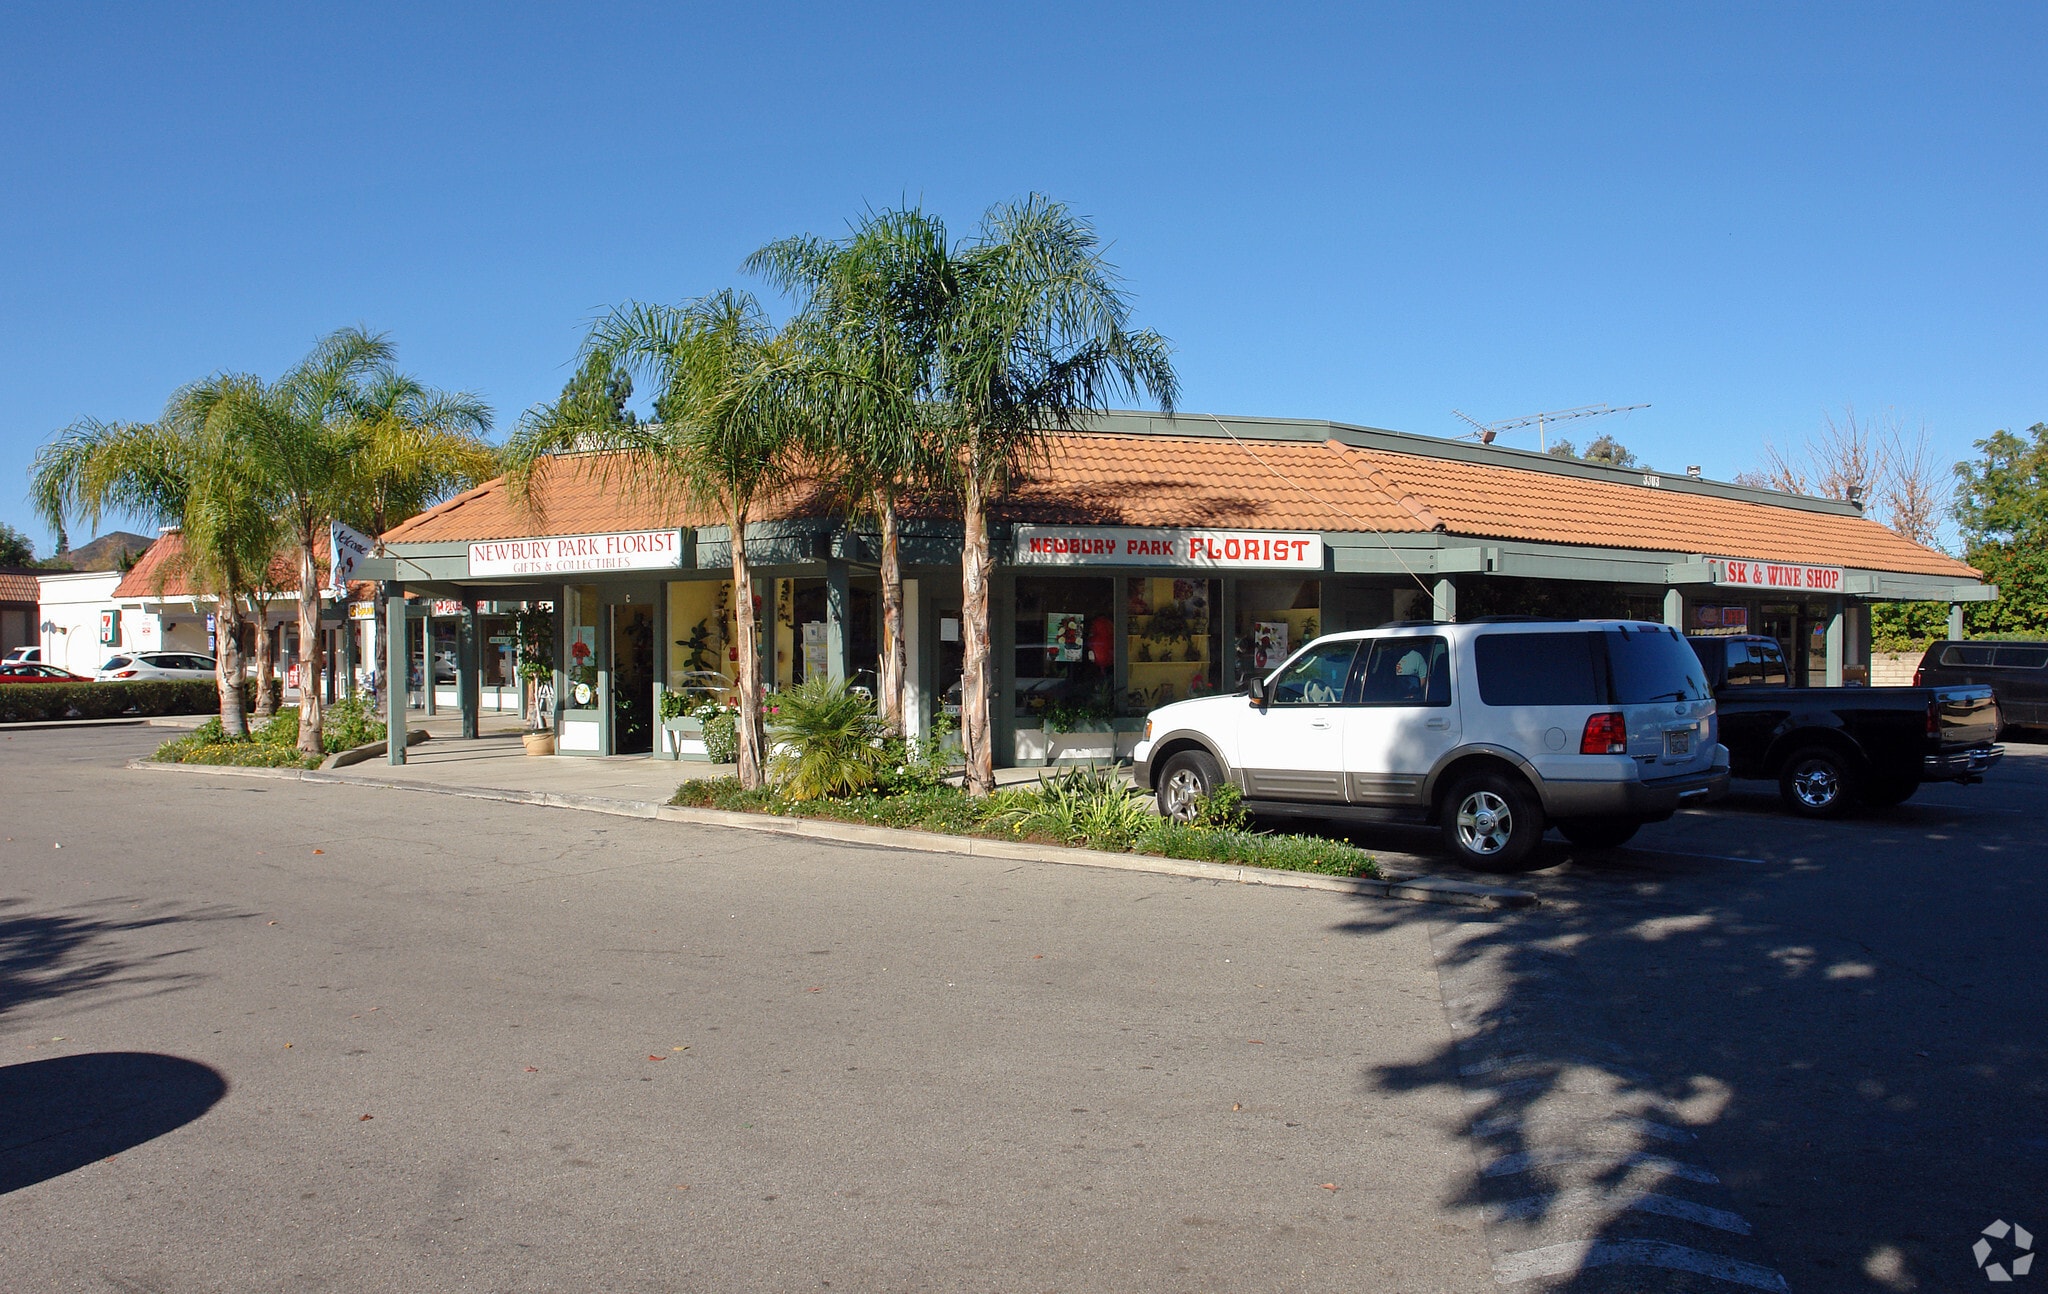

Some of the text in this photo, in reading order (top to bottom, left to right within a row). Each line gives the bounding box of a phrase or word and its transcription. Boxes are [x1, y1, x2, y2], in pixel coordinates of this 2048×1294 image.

[1643, 474, 1660, 487] 3303
[474, 533, 675, 562] NEWBURY PARK FLORIST
[1029, 537, 1311, 562] NEWBURY PARK FLORIST
[513, 556, 631, 573] GIFTS & COLLECTIBLES
[1753, 564, 1762, 584] &
[1766, 565, 1802, 587] WINE
[1806, 568, 1839, 589] SHOP
